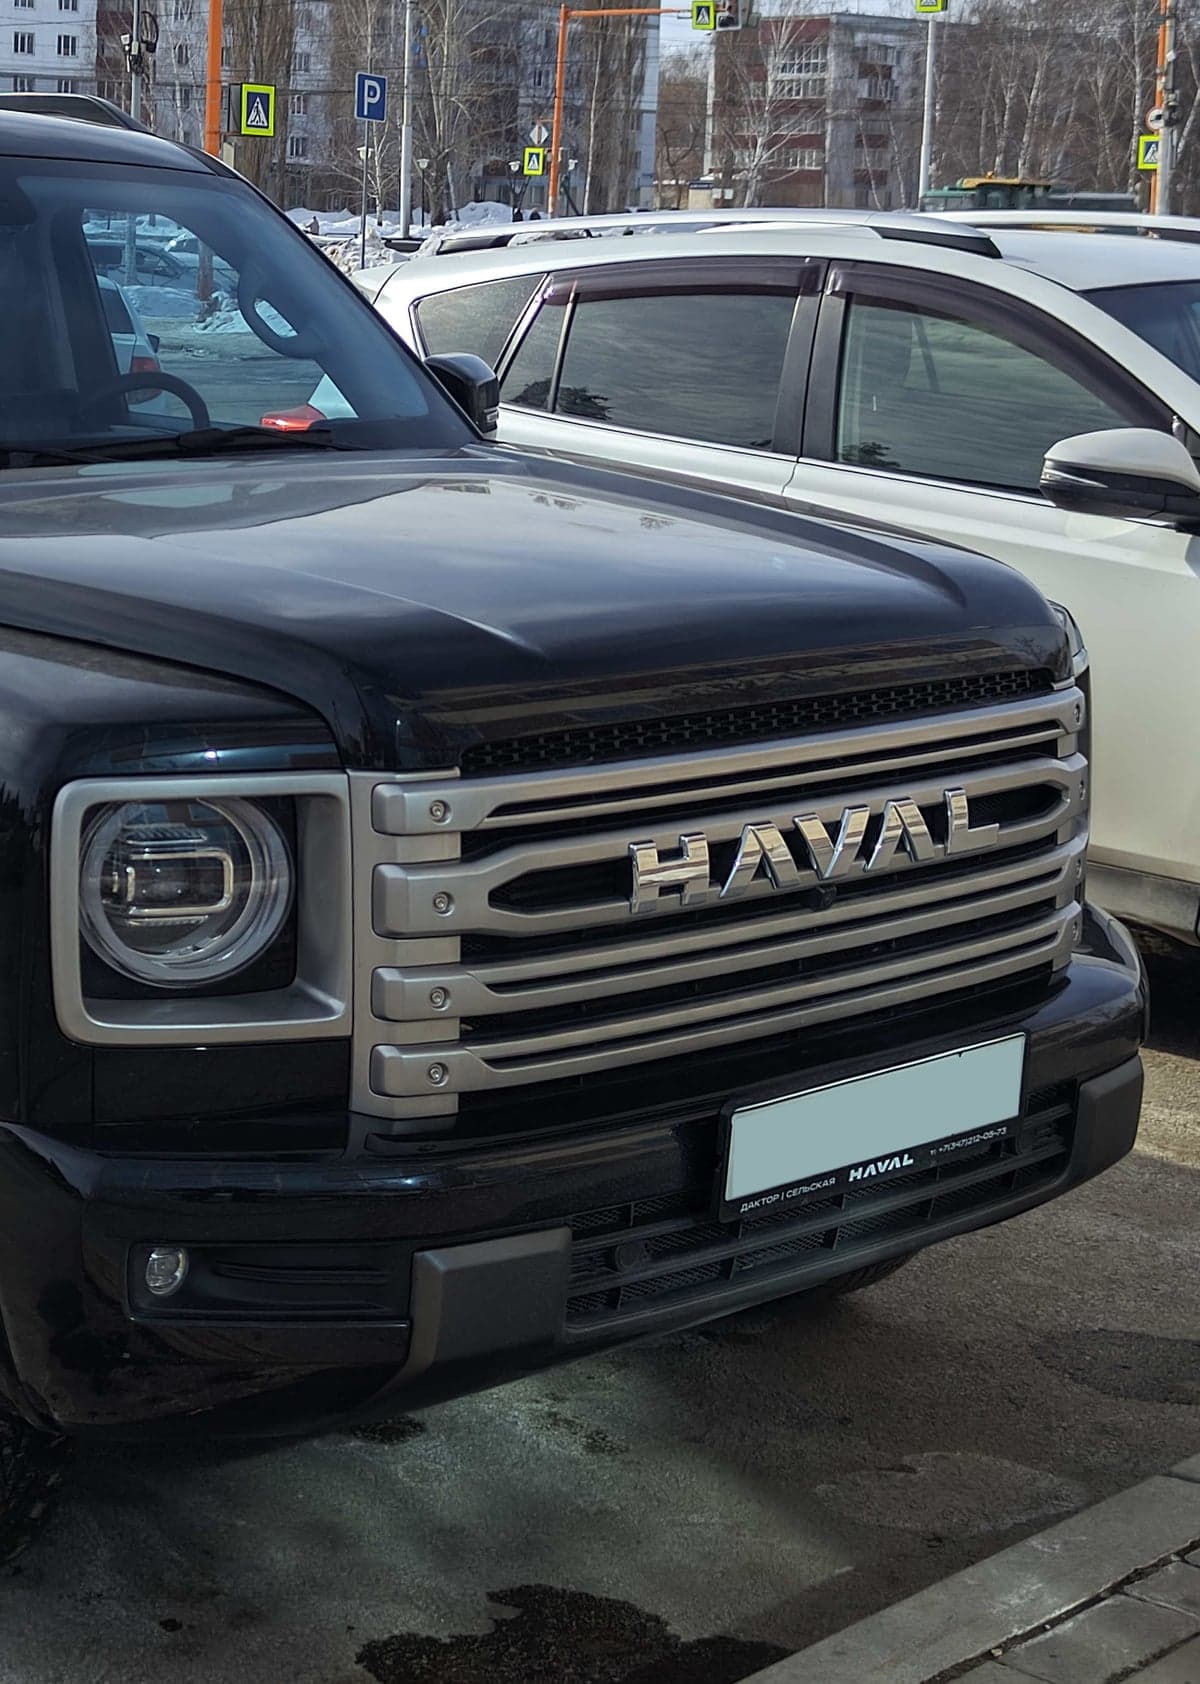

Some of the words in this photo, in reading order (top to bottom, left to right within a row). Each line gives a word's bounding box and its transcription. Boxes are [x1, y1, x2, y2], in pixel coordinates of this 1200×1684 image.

[363, 79, 381, 116] P
[628, 786, 1000, 915] HAVAL
[848, 1153, 914, 1182] HAVAL
[785, 1176, 837, 1199] СЕЛЬСКАЯ
